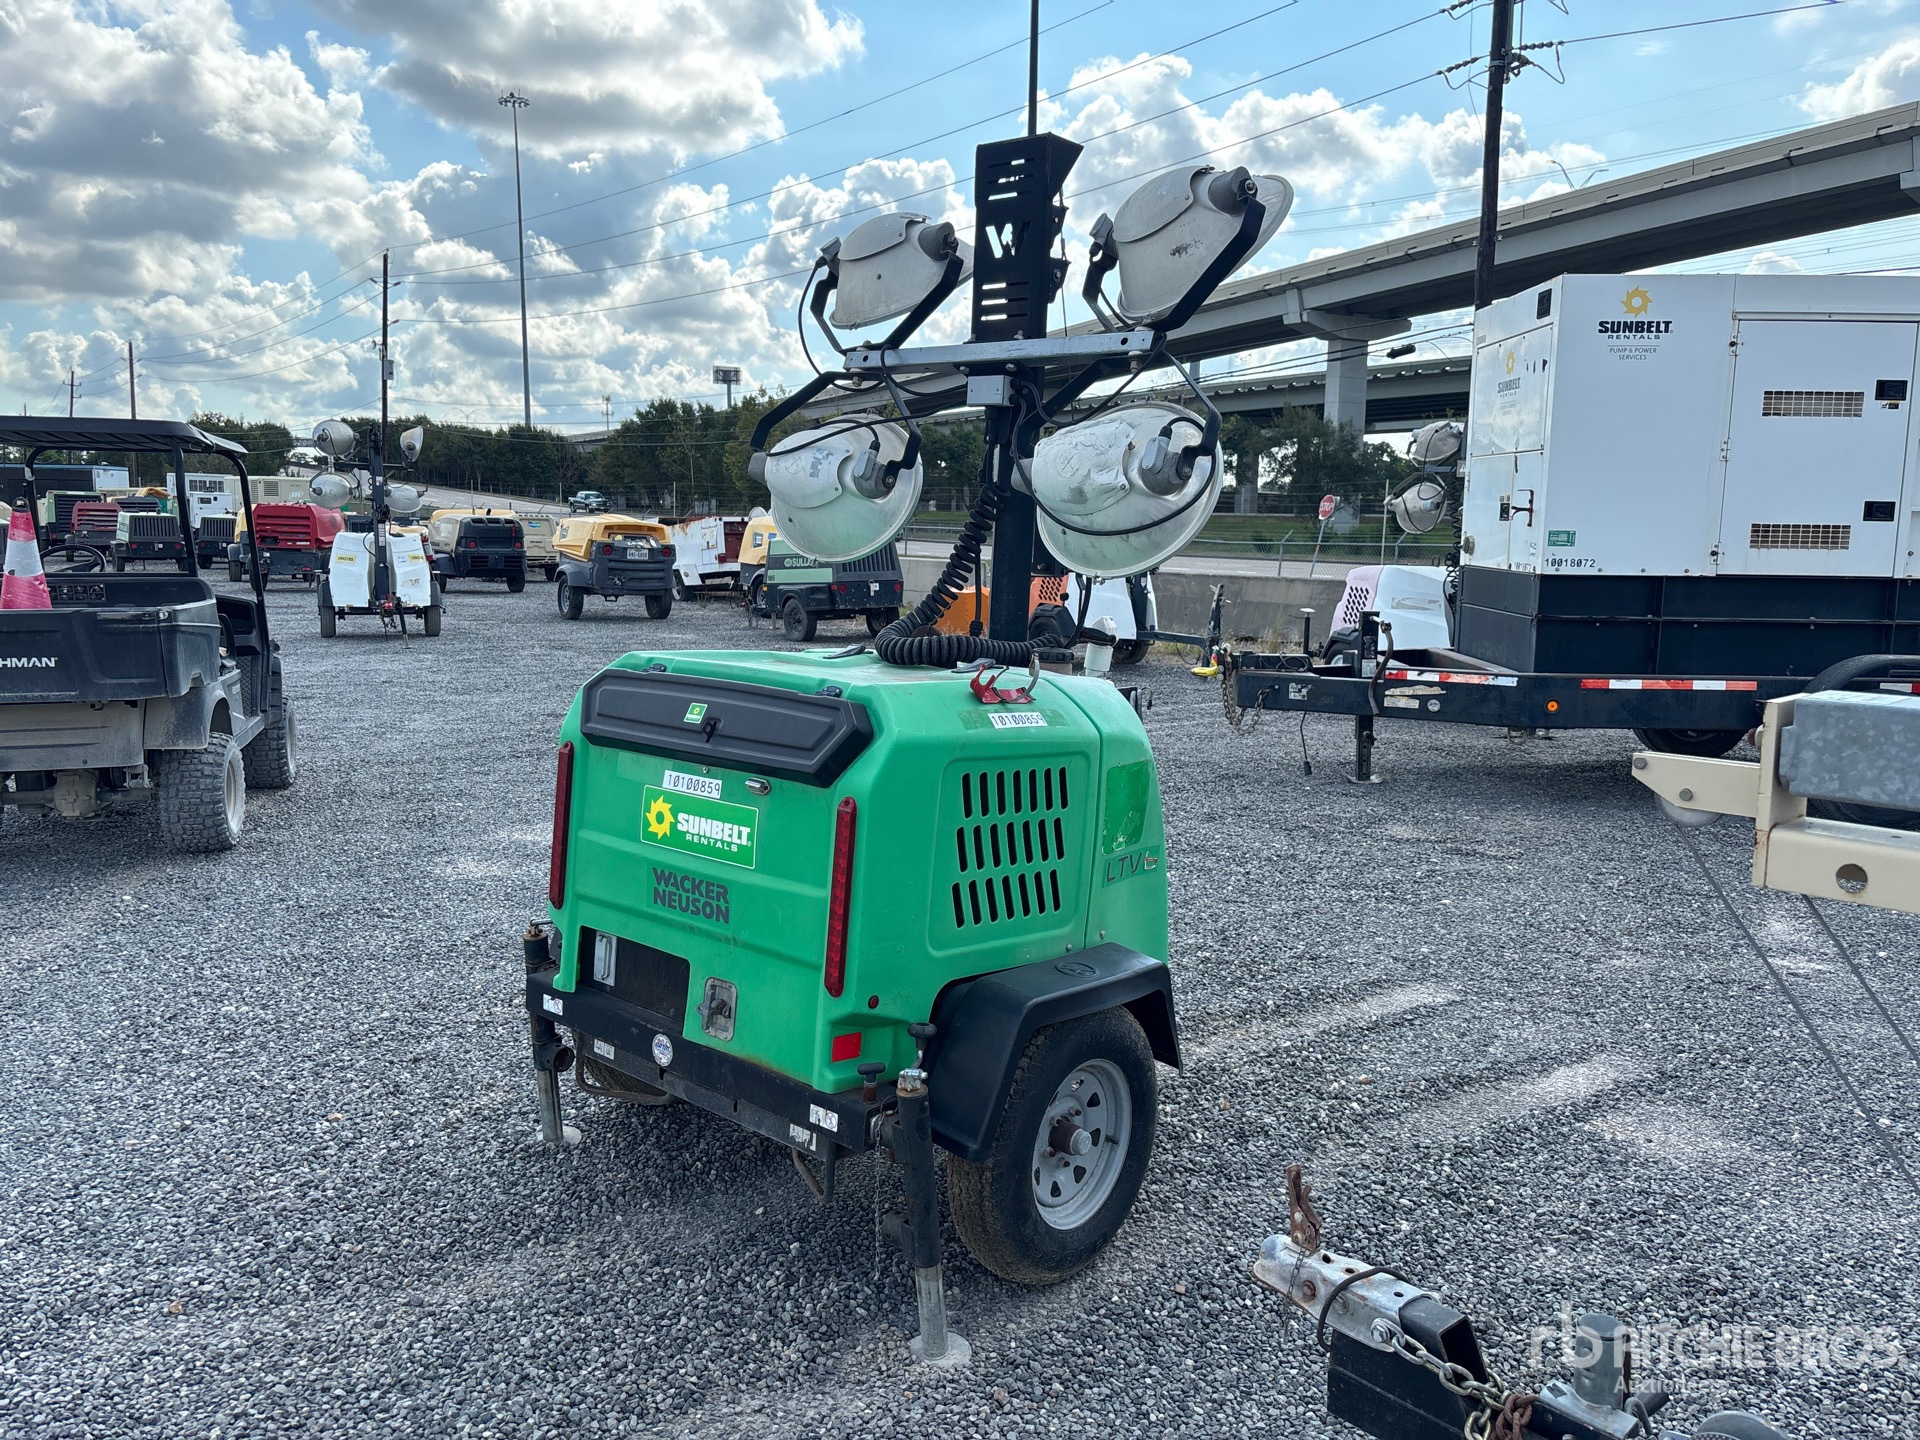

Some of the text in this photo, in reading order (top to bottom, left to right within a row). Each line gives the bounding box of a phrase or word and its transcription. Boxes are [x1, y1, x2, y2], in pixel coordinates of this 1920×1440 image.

[1320, 502, 1334, 511] STOP
[1544, 558, 1596, 568] 10018072
[991, 714, 1046, 726] 10100859
[667, 774, 721, 796] 10100859
[685, 833, 738, 852] RENTALS
[652, 866, 730, 905] WACKER
[653, 886, 730, 924] NEUSON
